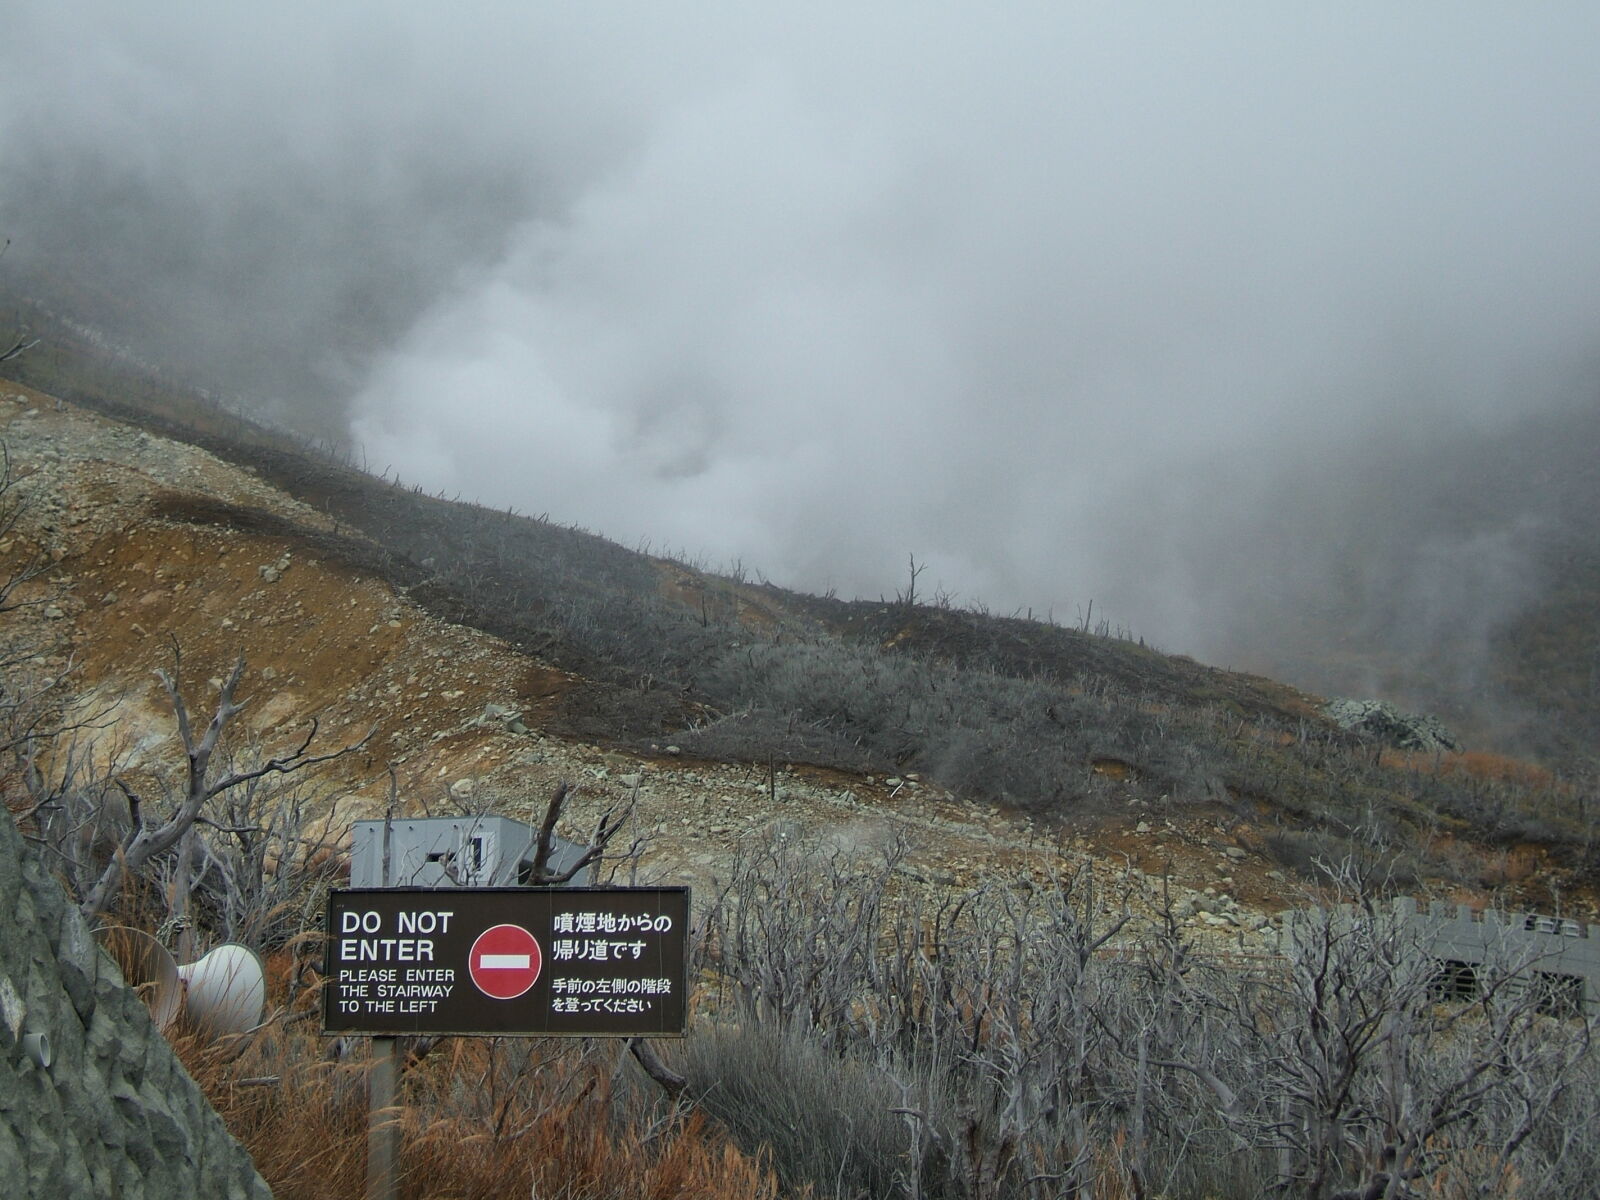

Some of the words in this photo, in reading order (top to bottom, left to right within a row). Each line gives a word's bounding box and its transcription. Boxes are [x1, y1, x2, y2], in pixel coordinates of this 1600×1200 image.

[342, 911, 382, 934] DO
[398, 911, 454, 934] NOT
[552, 912, 673, 934] 噴煙地からの
[340, 939, 434, 961] ENTER
[552, 939, 647, 961] 帰り道です
[339, 969, 397, 982] PLEASE
[406, 969, 455, 982] ENTER
[339, 984, 369, 998] THE
[377, 984, 454, 998] STAIRWAY
[551, 977, 672, 994] 手前の左側の階段
[339, 1000, 360, 1013] TO
[365, 1000, 395, 1013] THE
[399, 1000, 438, 1013] LEFT
[551, 997, 652, 1013] を登ってください
